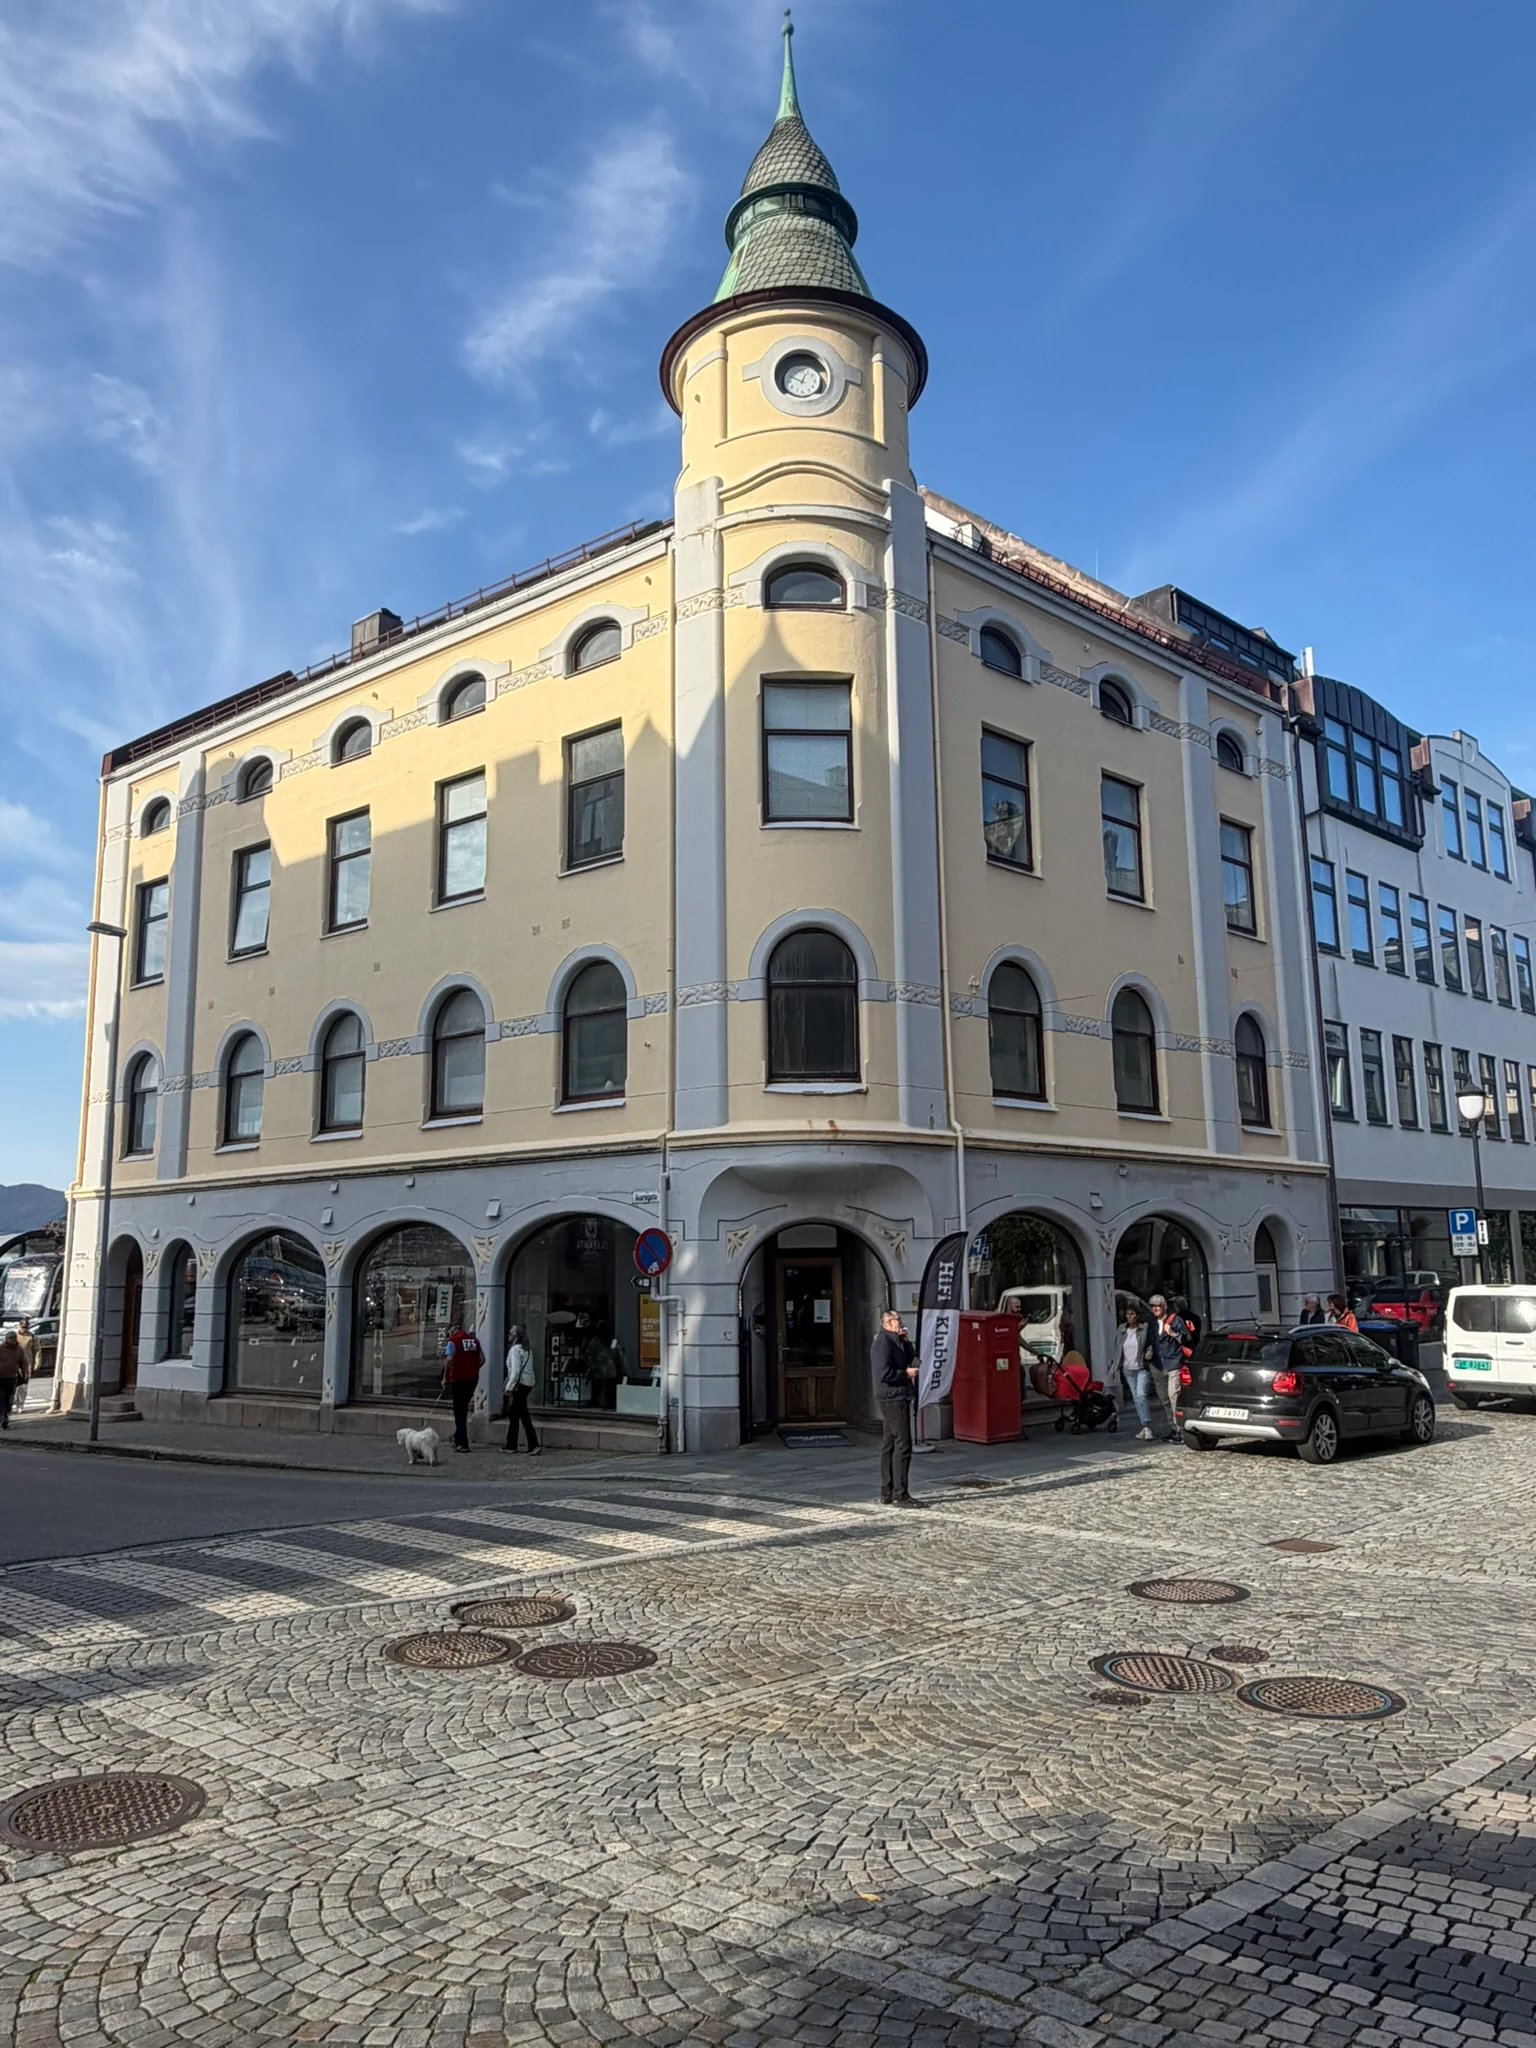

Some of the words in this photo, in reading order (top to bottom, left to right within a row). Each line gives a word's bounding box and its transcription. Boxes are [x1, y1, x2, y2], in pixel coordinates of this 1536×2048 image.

[1455, 1212, 1469, 1231] P
[937, 1261, 954, 1302] HiFi
[931, 1316, 949, 1391] Klubben
